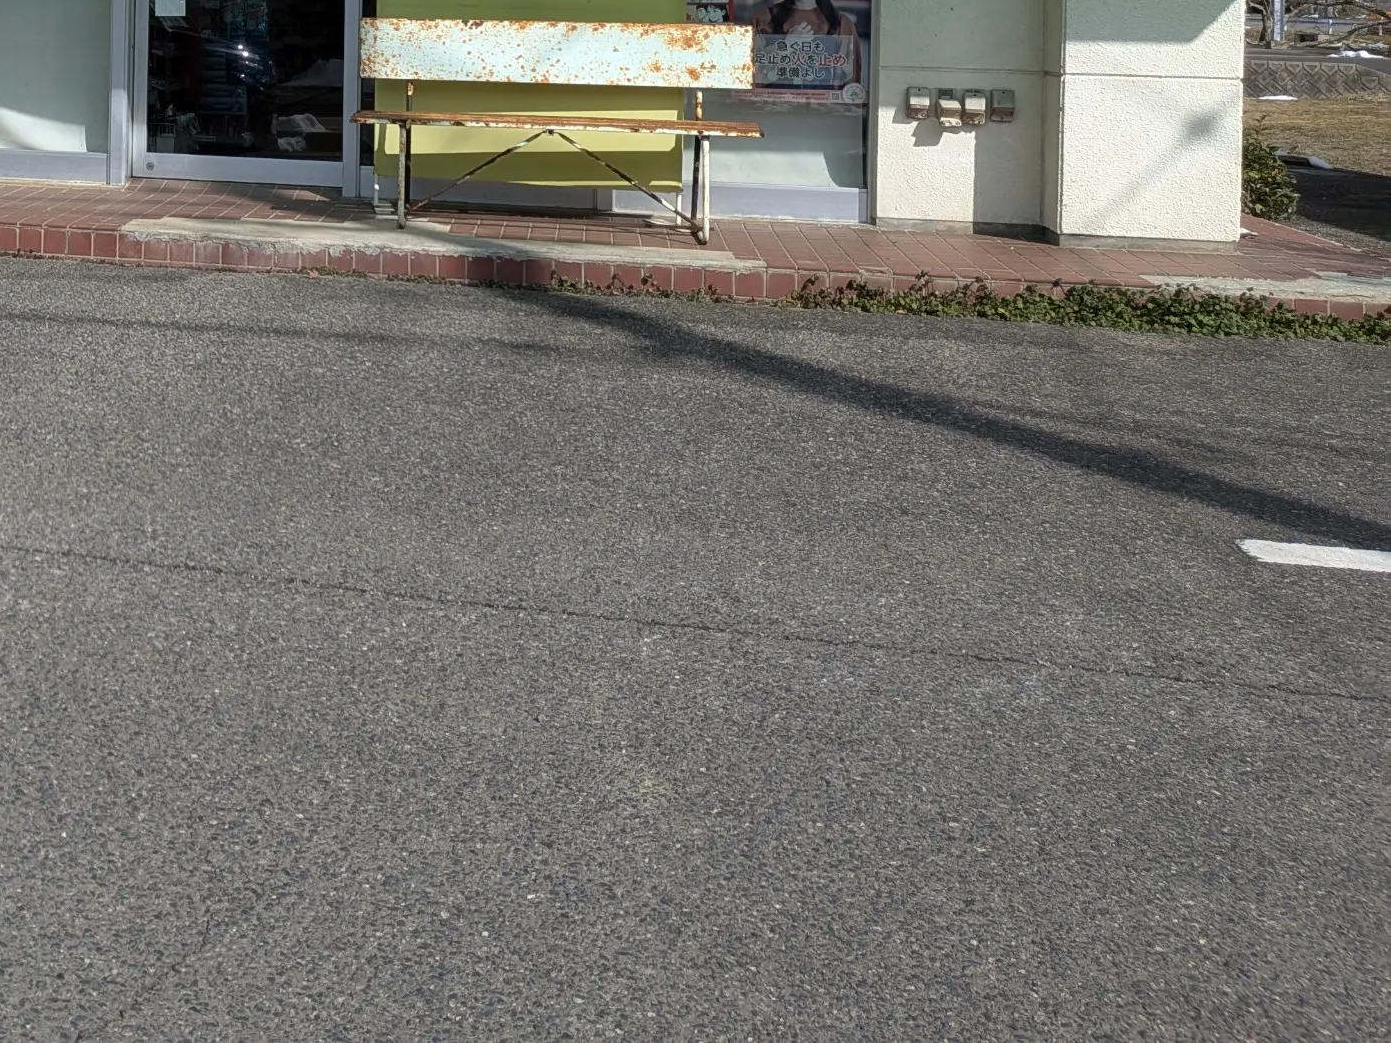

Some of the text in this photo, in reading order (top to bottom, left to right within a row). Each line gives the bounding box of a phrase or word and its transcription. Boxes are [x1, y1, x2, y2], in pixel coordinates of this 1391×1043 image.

[775, 41, 825, 52] 急ぐ日も
[754, 53, 847, 67] 足止め火を止め
[775, 66, 826, 79] 準備よし
